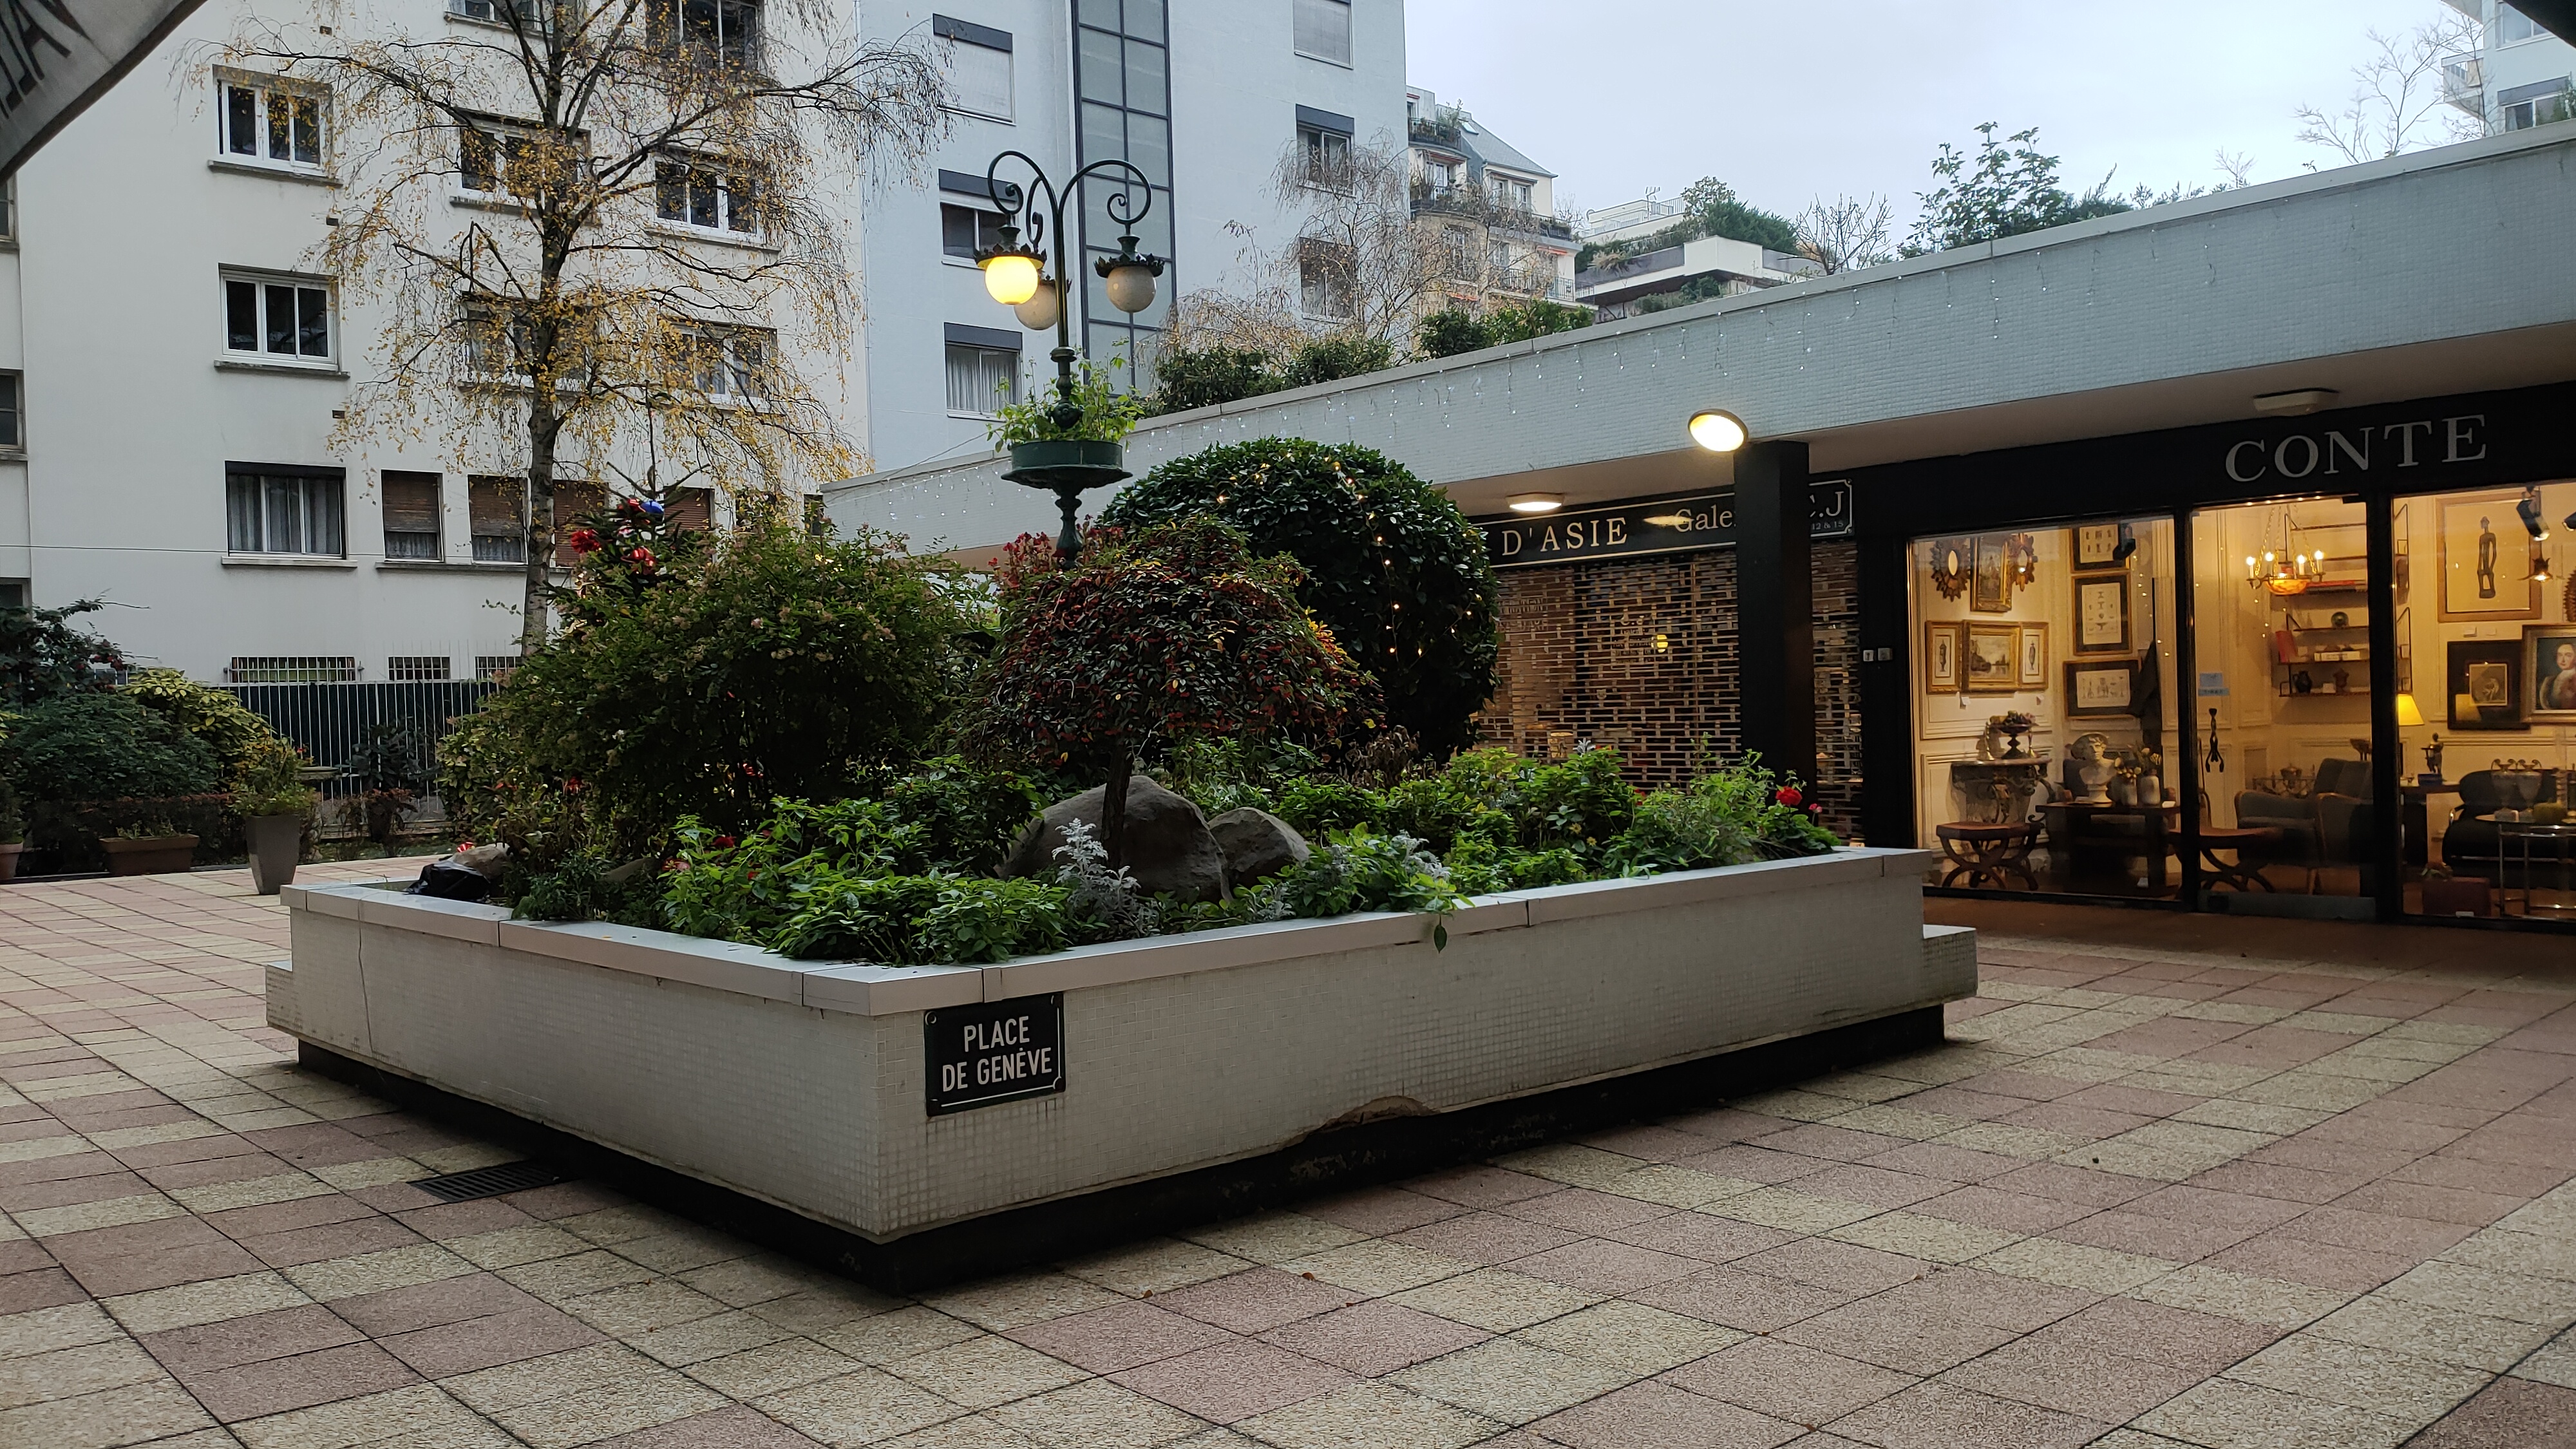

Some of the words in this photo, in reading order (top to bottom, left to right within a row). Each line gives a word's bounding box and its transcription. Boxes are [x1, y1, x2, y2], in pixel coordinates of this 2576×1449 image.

[2226, 415, 2486, 482] CONTE
[1502, 517, 1627, 556] D'ASIE
[1674, 504, 1736, 533] Gale
[965, 1016, 1030, 1052] PLACE
[943, 1061, 968, 1092] DE
